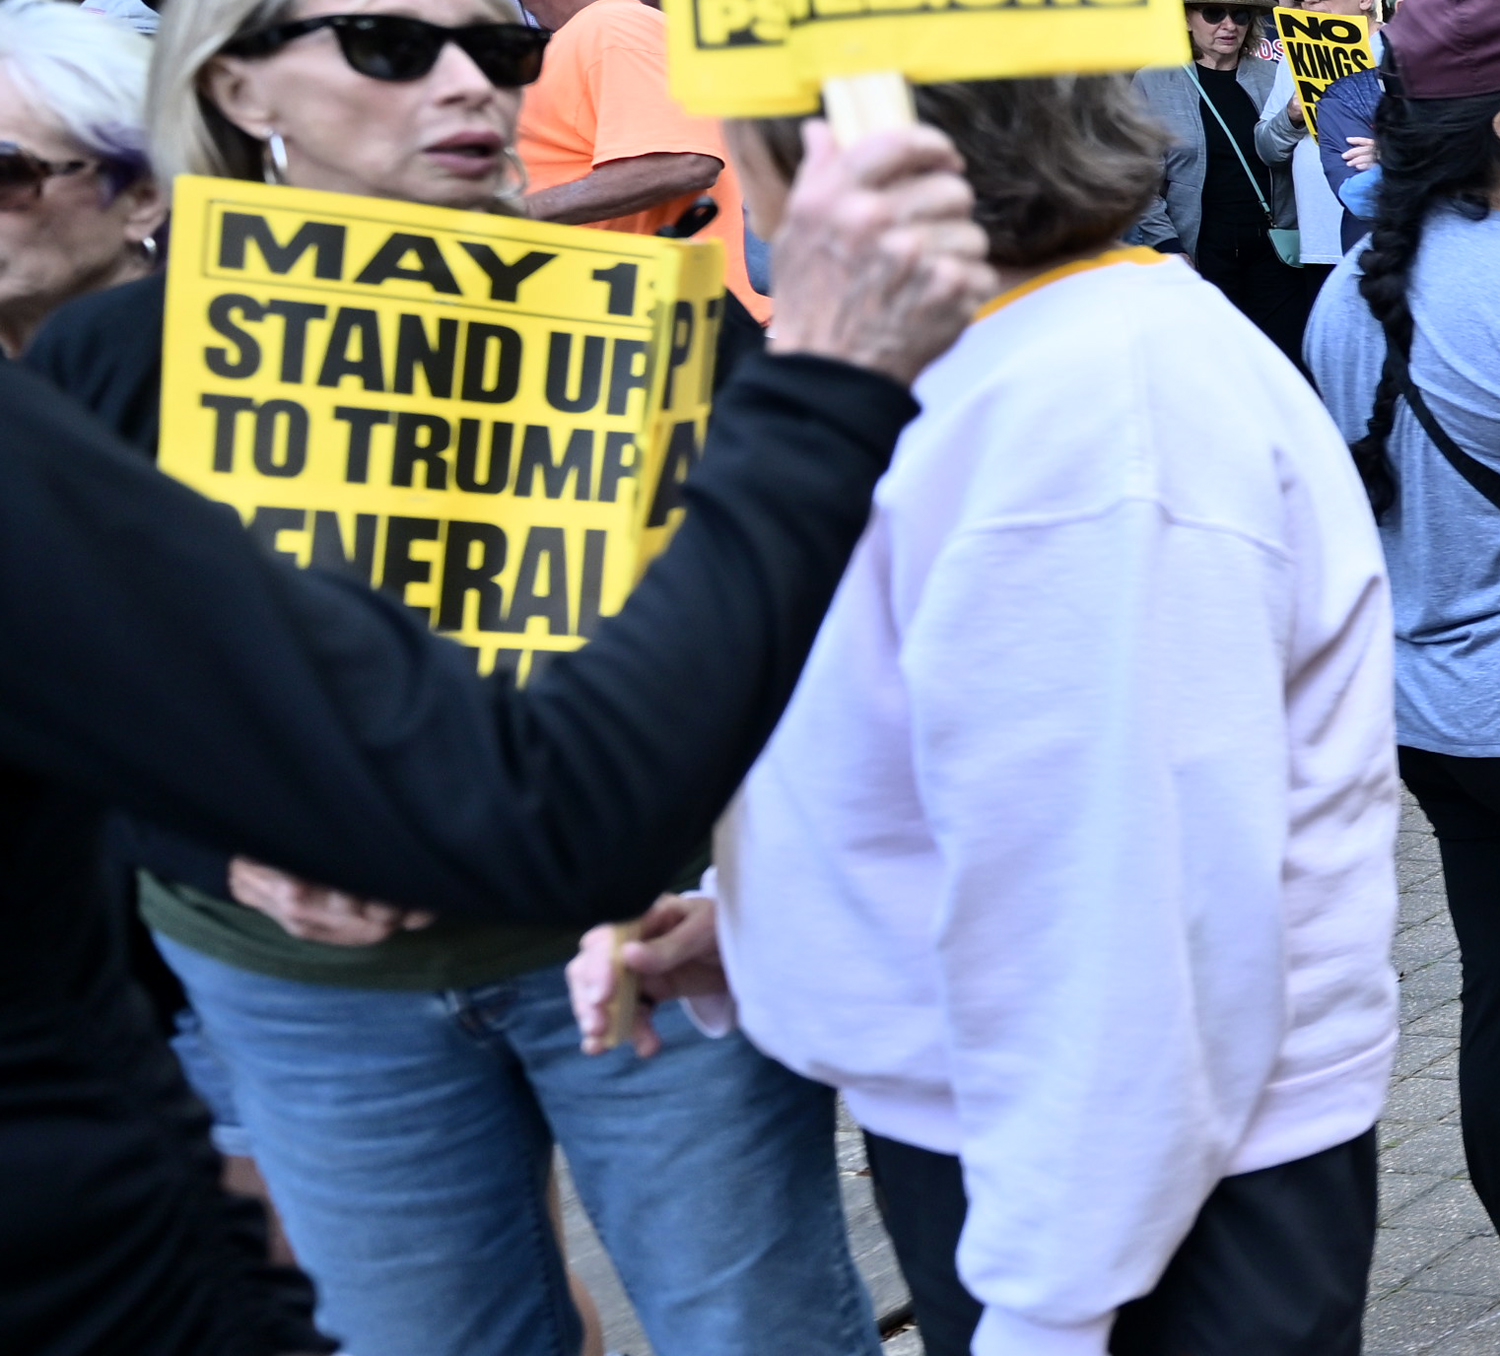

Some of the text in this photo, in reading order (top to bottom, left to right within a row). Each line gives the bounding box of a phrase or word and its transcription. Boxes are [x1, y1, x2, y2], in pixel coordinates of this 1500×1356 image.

[1279, 14, 1362, 44] NO
[1286, 42, 1368, 80] KINGS
[217, 211, 559, 304] MAY
[202, 293, 522, 405] STAND
[545, 330, 647, 416] UP
[201, 392, 310, 480] TO
[333, 405, 638, 504] TRUMP
